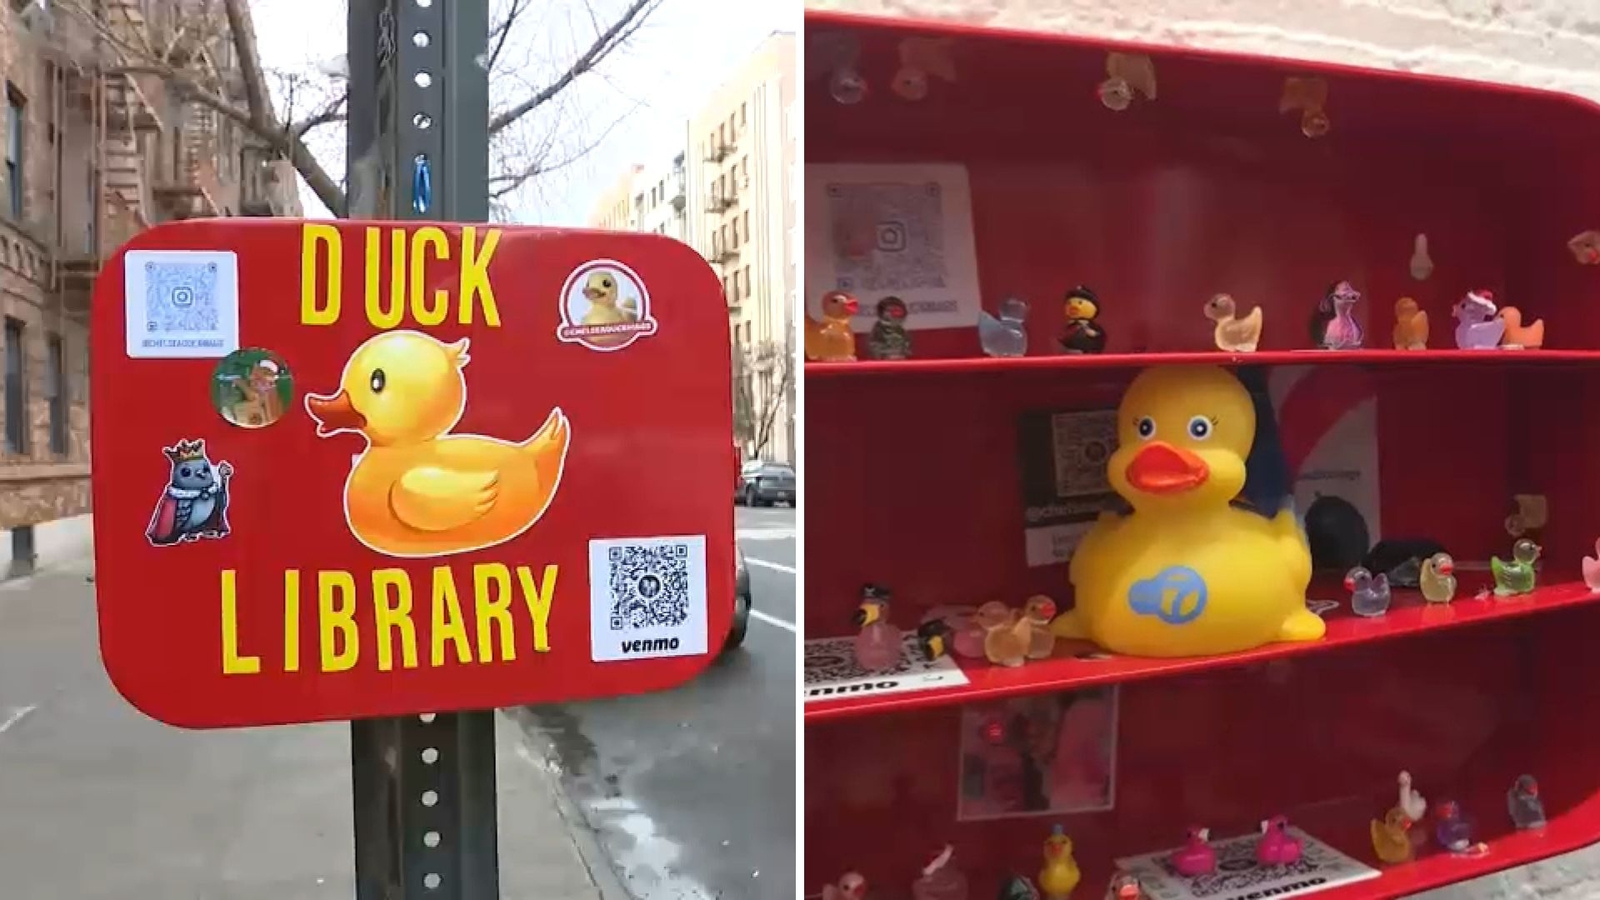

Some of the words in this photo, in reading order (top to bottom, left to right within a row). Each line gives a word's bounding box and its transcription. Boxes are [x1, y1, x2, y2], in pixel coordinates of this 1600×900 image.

[300, 224, 501, 328] DUCK
[221, 563, 558, 675] LIBRARY
[621, 637, 680, 654] venmo
[804, 681, 898, 697] nmo
